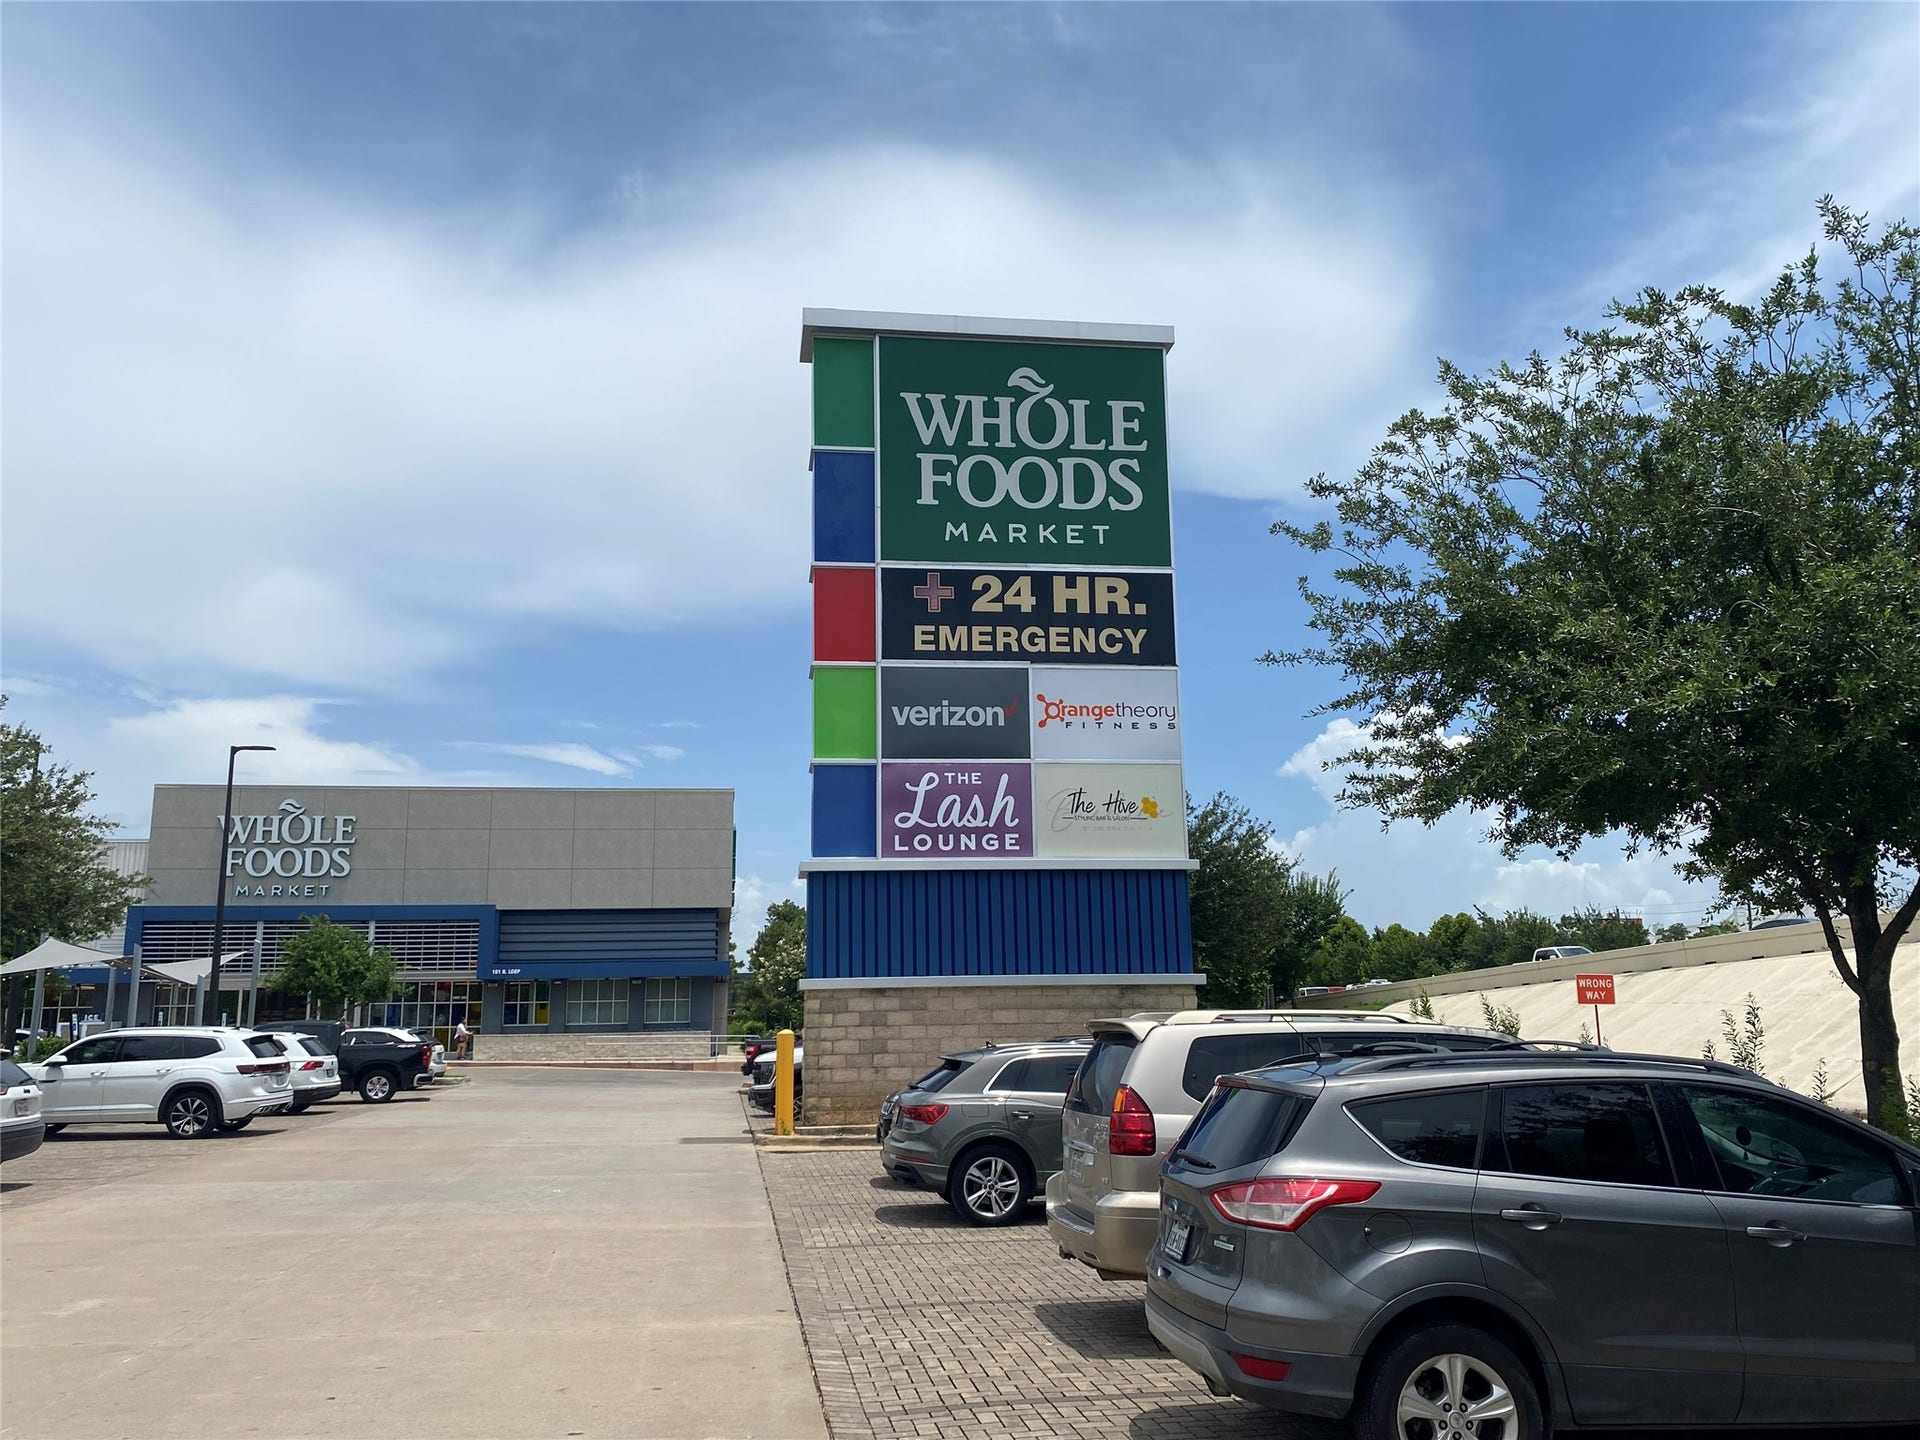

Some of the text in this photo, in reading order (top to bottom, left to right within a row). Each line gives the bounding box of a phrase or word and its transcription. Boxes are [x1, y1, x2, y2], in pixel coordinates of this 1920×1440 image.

[900, 367, 1148, 451] WHOLE
[916, 453, 1144, 511] FOODS
[945, 521, 1110, 545] MARKET
[971, 575, 1147, 615] 24 HR.
[913, 625, 1148, 654] EMERGENCY
[891, 699, 1005, 727] verizon
[1065, 721, 1176, 730] FITNESS
[944, 772, 982, 785] THE
[894, 771, 1020, 829] Lash
[1067, 787, 1139, 815] The Hive
[217, 798, 357, 845] WHOLE
[894, 833, 1020, 852] LOUNGE
[226, 847, 351, 878] FOODS
[235, 884, 330, 897] MARKET
[1578, 979, 1612, 988] WRONG
[1586, 991, 1606, 1000] WAY
